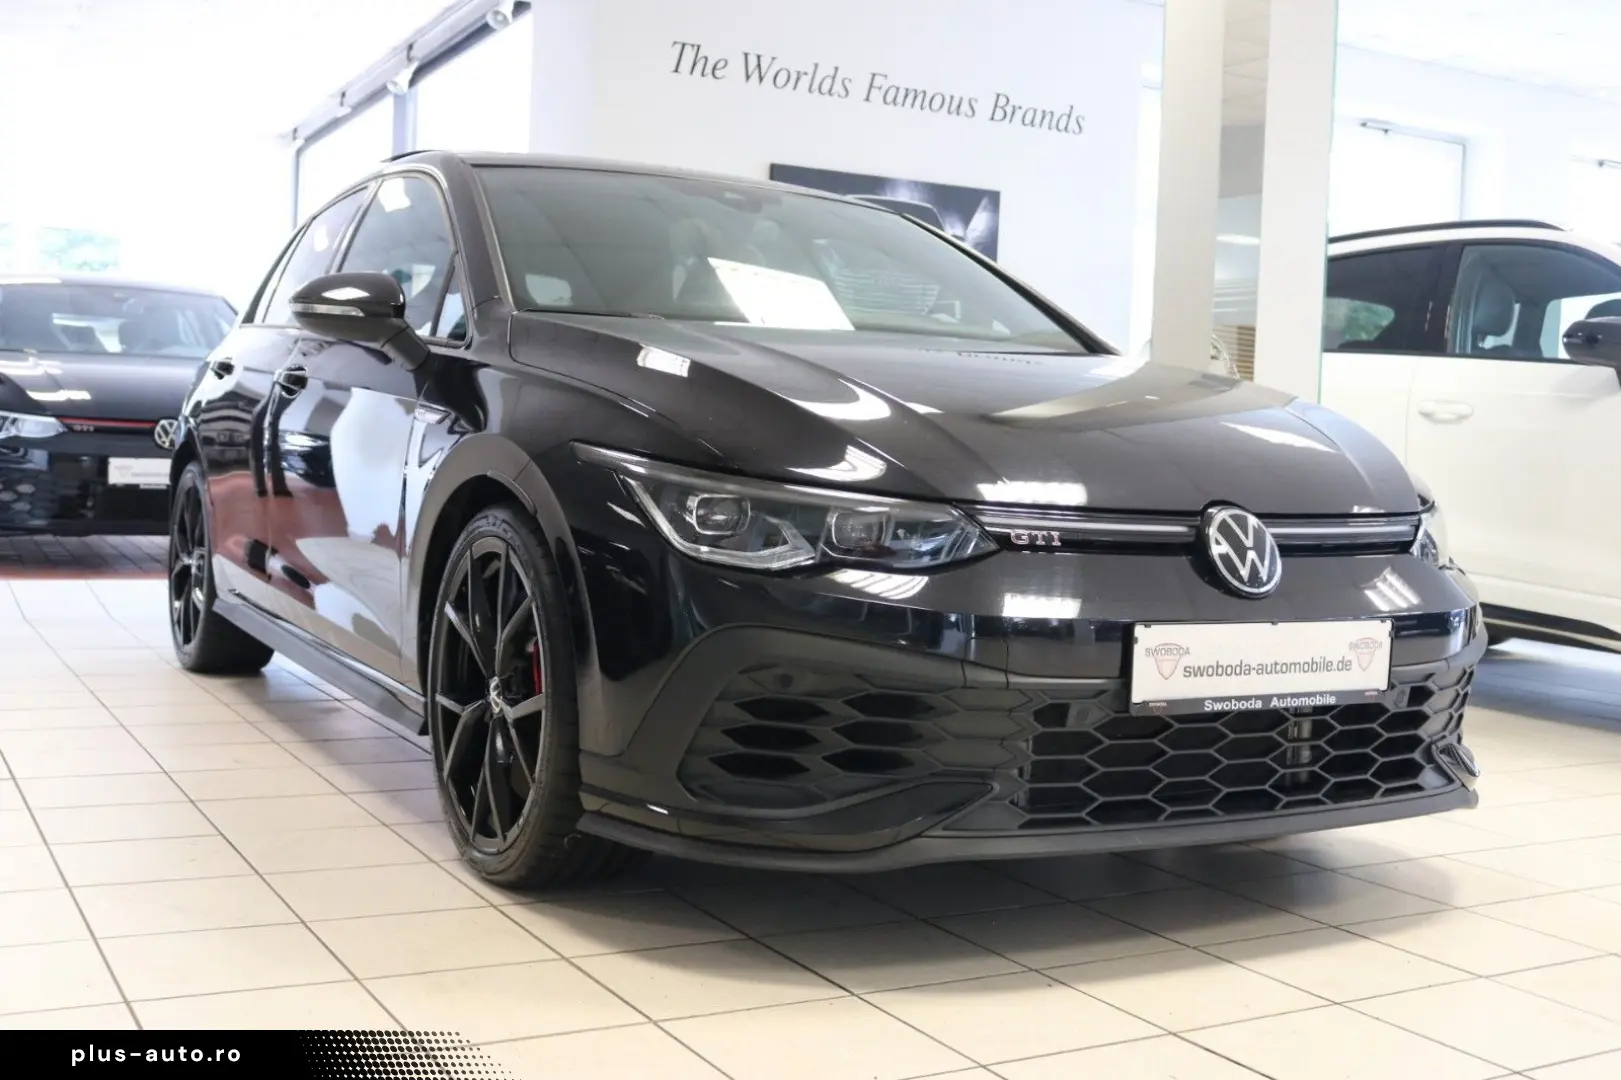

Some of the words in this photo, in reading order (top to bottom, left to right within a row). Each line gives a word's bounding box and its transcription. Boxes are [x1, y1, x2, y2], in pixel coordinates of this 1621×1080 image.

[670, 40, 729, 81] The
[741, 51, 853, 100] Worlds
[863, 72, 979, 120] Famous
[988, 92, 1086, 136] Brands
[1010, 530, 1062, 546] GTI
[1145, 646, 1191, 657] SWOBODA
[1183, 655, 1352, 679] swoboda-automobile.de
[1203, 699, 1263, 711] Swoboda
[1269, 693, 1336, 708] Automobile
